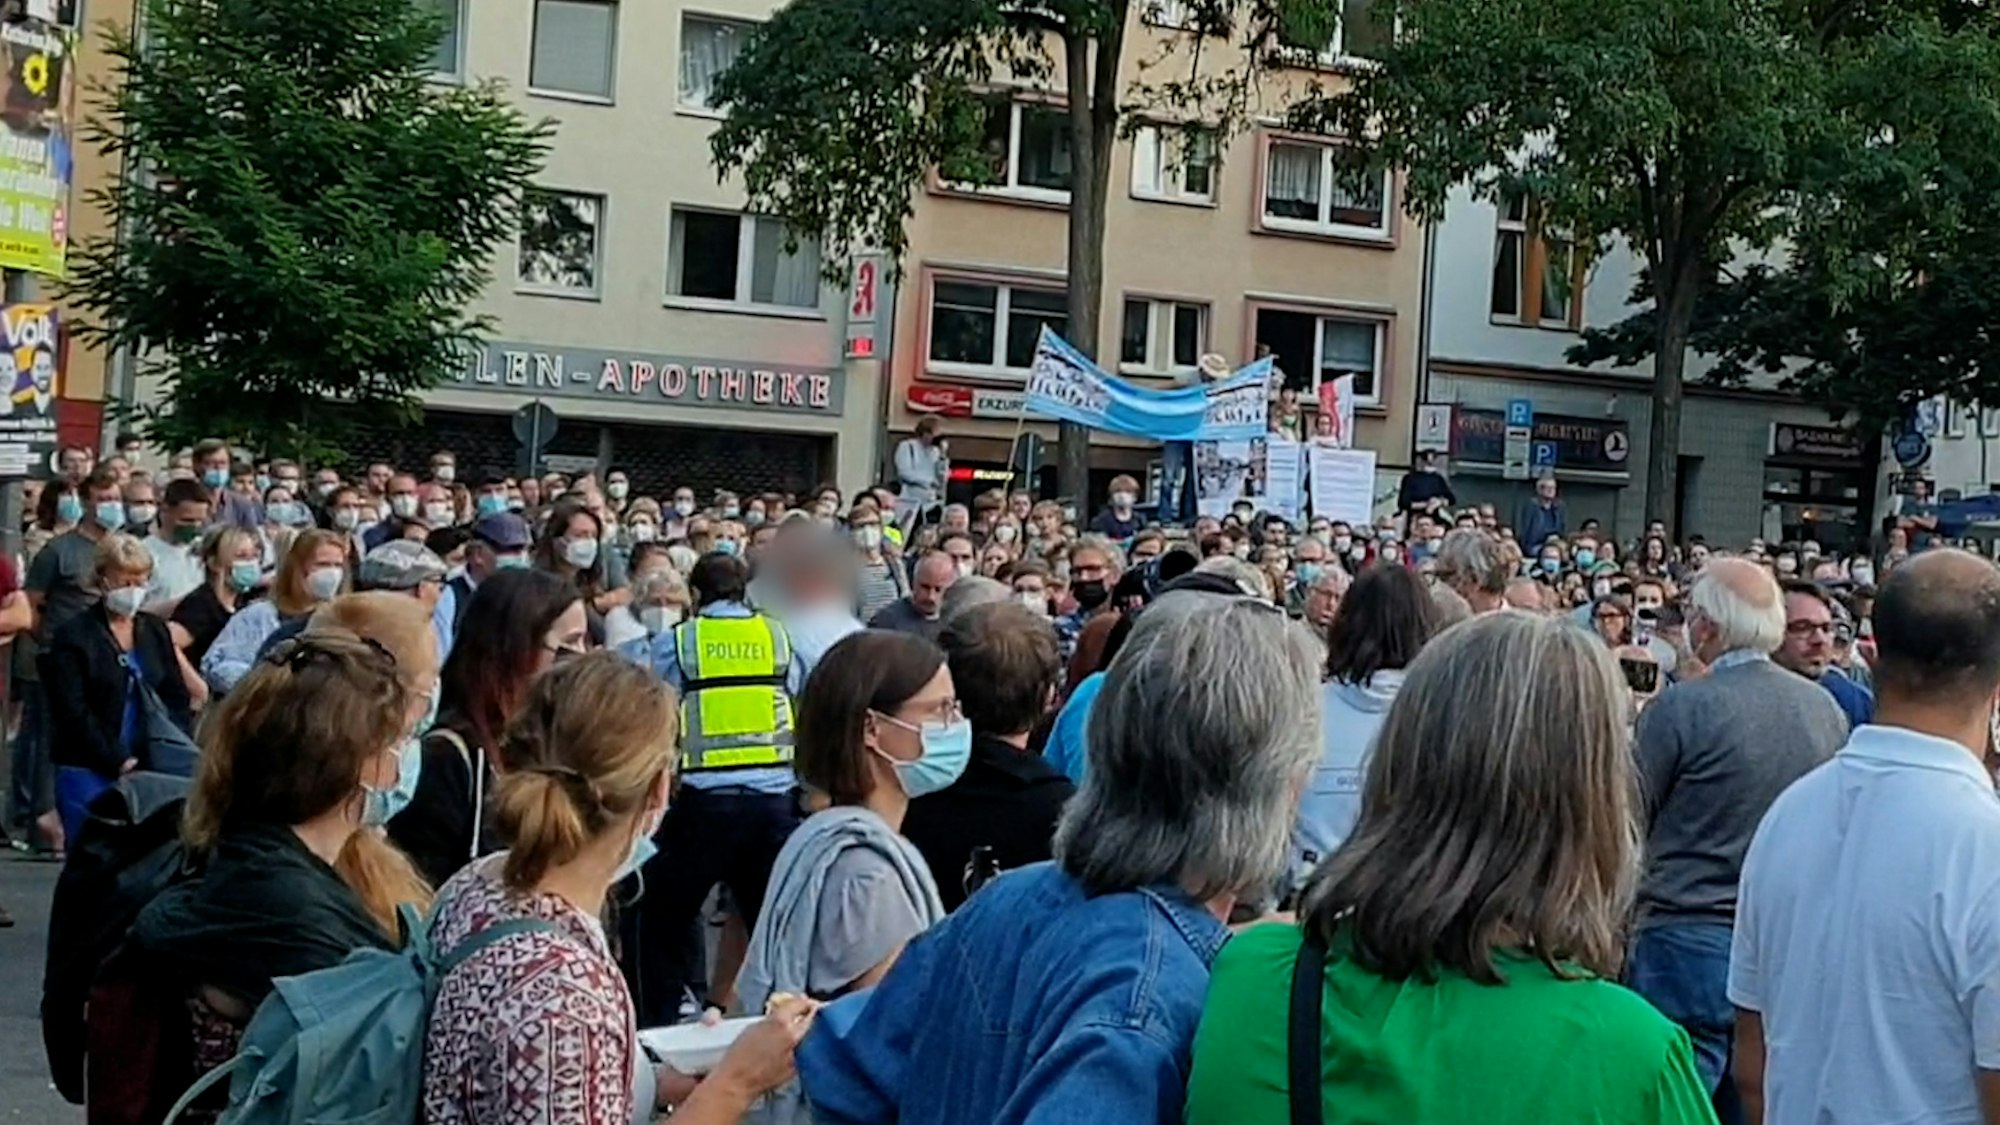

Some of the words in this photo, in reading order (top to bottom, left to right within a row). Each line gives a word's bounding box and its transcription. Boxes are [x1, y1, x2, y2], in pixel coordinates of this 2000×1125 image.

[2, 309, 53, 346] Volt
[1536, 444, 1551, 464] P
[705, 642, 766, 660] POLIZEI
